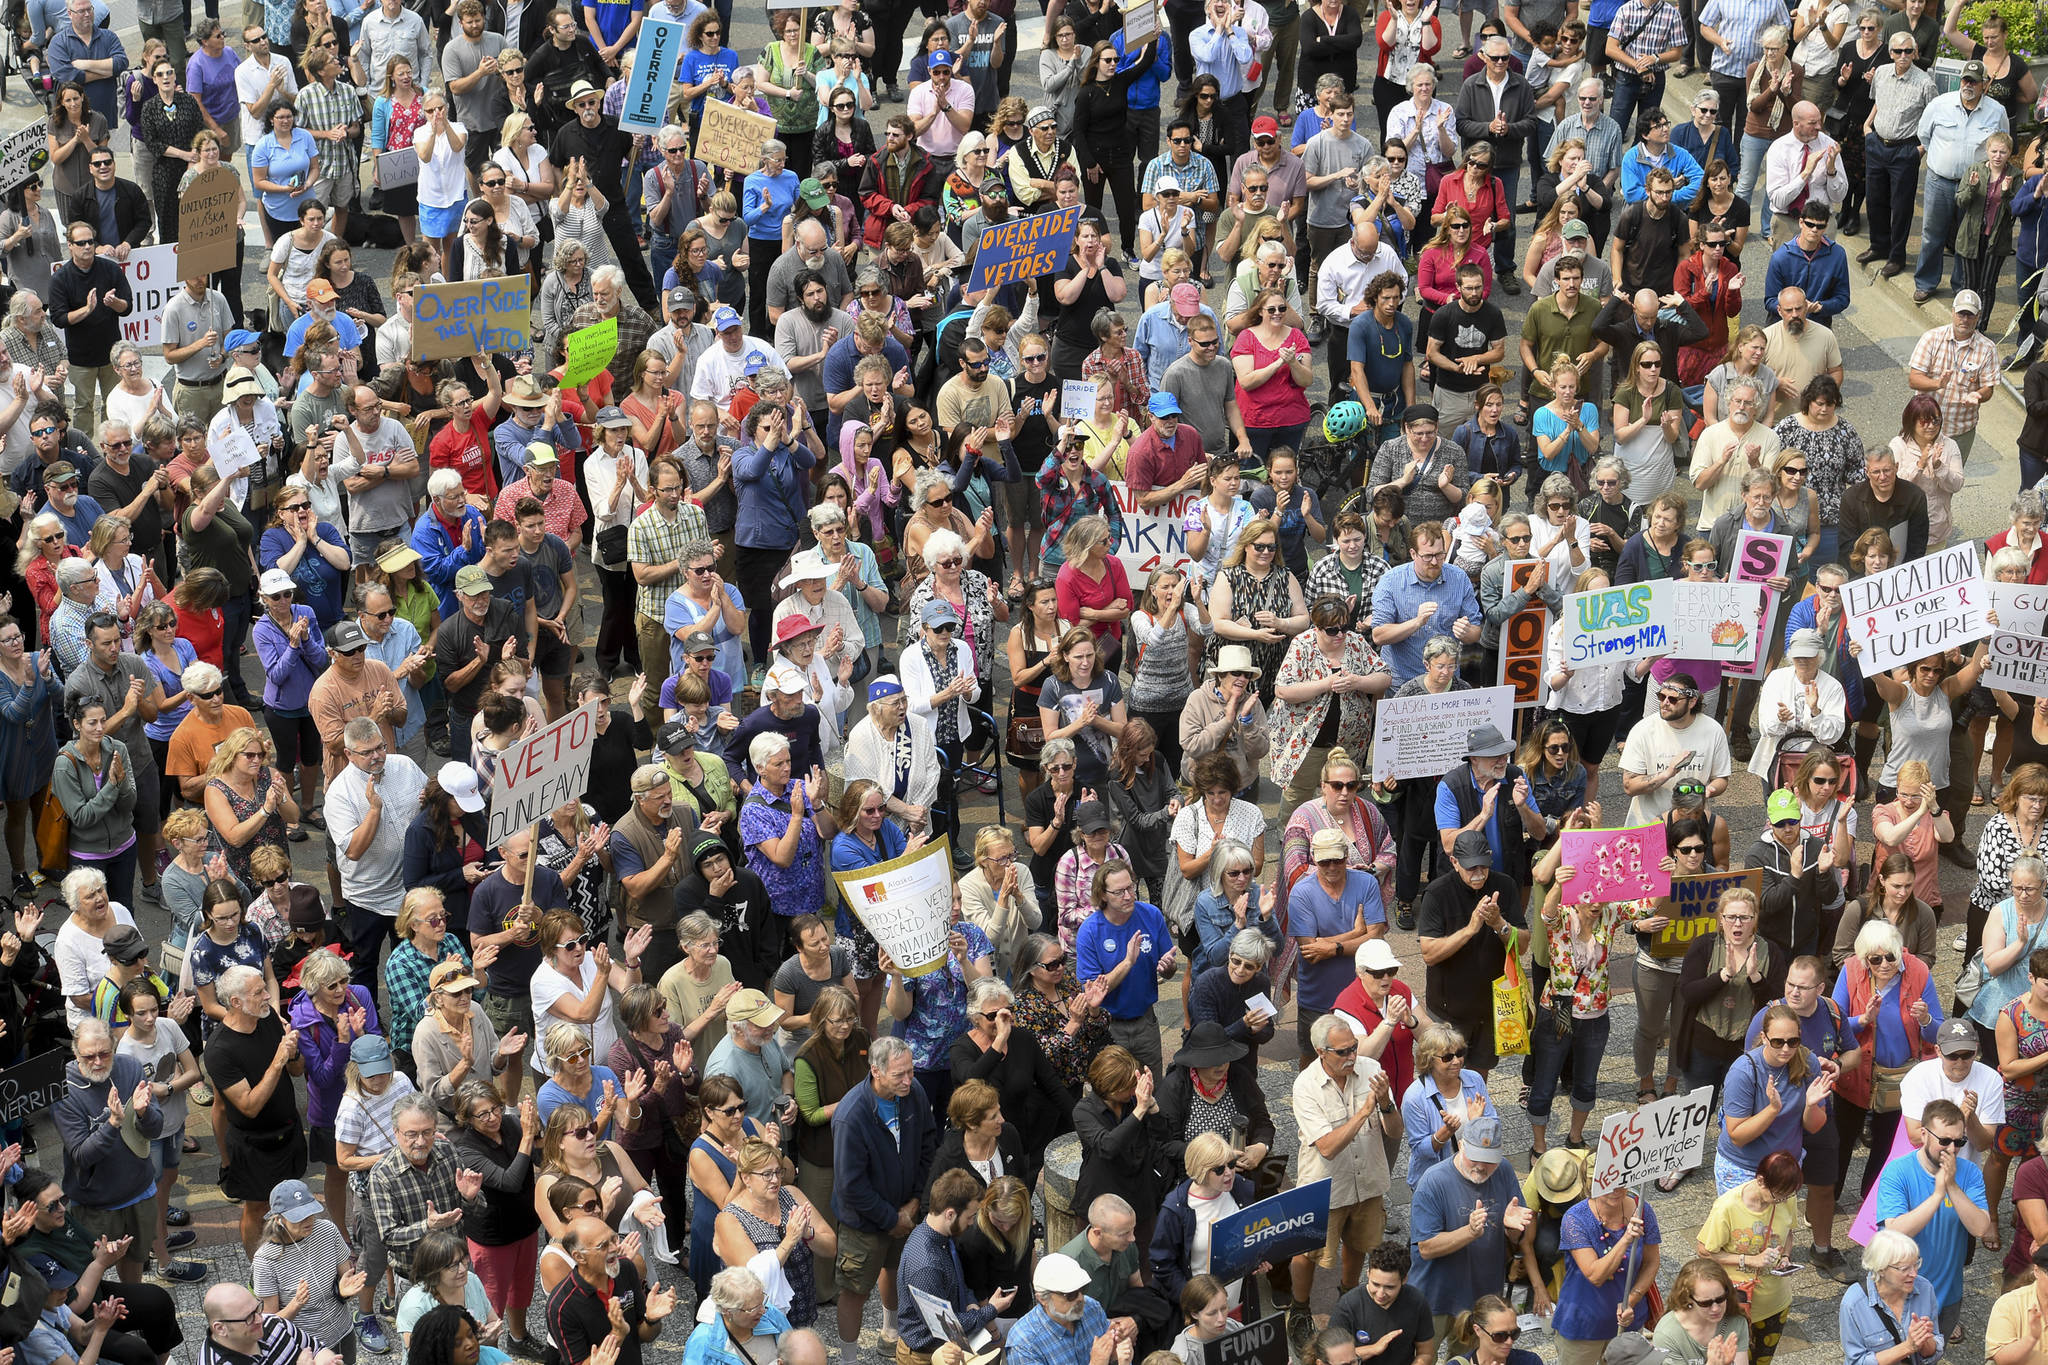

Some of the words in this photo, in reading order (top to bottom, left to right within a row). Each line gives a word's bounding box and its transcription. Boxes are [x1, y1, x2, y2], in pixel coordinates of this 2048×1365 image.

[639, 27, 668, 114] OVERRIDE
[18, 123, 47, 142] TRADE
[708, 110, 771, 144] OVERRIDE
[3, 154, 16, 168] AK
[16, 136, 47, 159] QUALITY
[712, 129, 729, 145] THE
[730, 136, 761, 159] VETOE
[200, 169, 219, 184] RIP
[180, 189, 236, 215] UNIVERSITY
[189, 211, 225, 230] ALASKA
[981, 208, 1076, 250] OVERRIDE
[1010, 241, 1037, 259] THE
[118, 260, 150, 281] TO
[983, 249, 1057, 286] VETOES
[415, 281, 528, 322] OVERRIDE
[433, 319, 468, 341] THE
[1741, 539, 1778, 576] S
[1848, 547, 1973, 617] EDUCATION
[1576, 585, 1653, 633] UAS
[1895, 607, 1909, 623] IS
[1914, 595, 1949, 616] OUR
[1871, 609, 1983, 663] FUTURE
[1383, 698, 1428, 716] ALASKA
[1431, 702, 1439, 711] IS
[1441, 699, 1460, 710] MORE
[1463, 697, 1481, 708] THAN
[1486, 696, 1495, 705] A
[1391, 723, 1413, 735] FUND
[1456, 717, 1482, 728] FUTURE
[501, 711, 589, 790] VETO
[489, 756, 590, 846] DUNLEAVY
[887, 875, 914, 889] Alaska
[872, 916, 925, 942] EDICAID
[1502, 1039, 1525, 1051] Bag!
[1601, 1111, 1644, 1159] YES
[1654, 1102, 1708, 1140] VETO
[1623, 1132, 1701, 1170] Overrides
[1594, 1164, 1620, 1190] YES
[1618, 1164, 1660, 1186] Income
[1663, 1155, 1685, 1172] Tax
[1243, 1212, 1315, 1248] STRONG
[1244, 1215, 1272, 1236] UA
[1220, 1322, 1275, 1362] FUND
